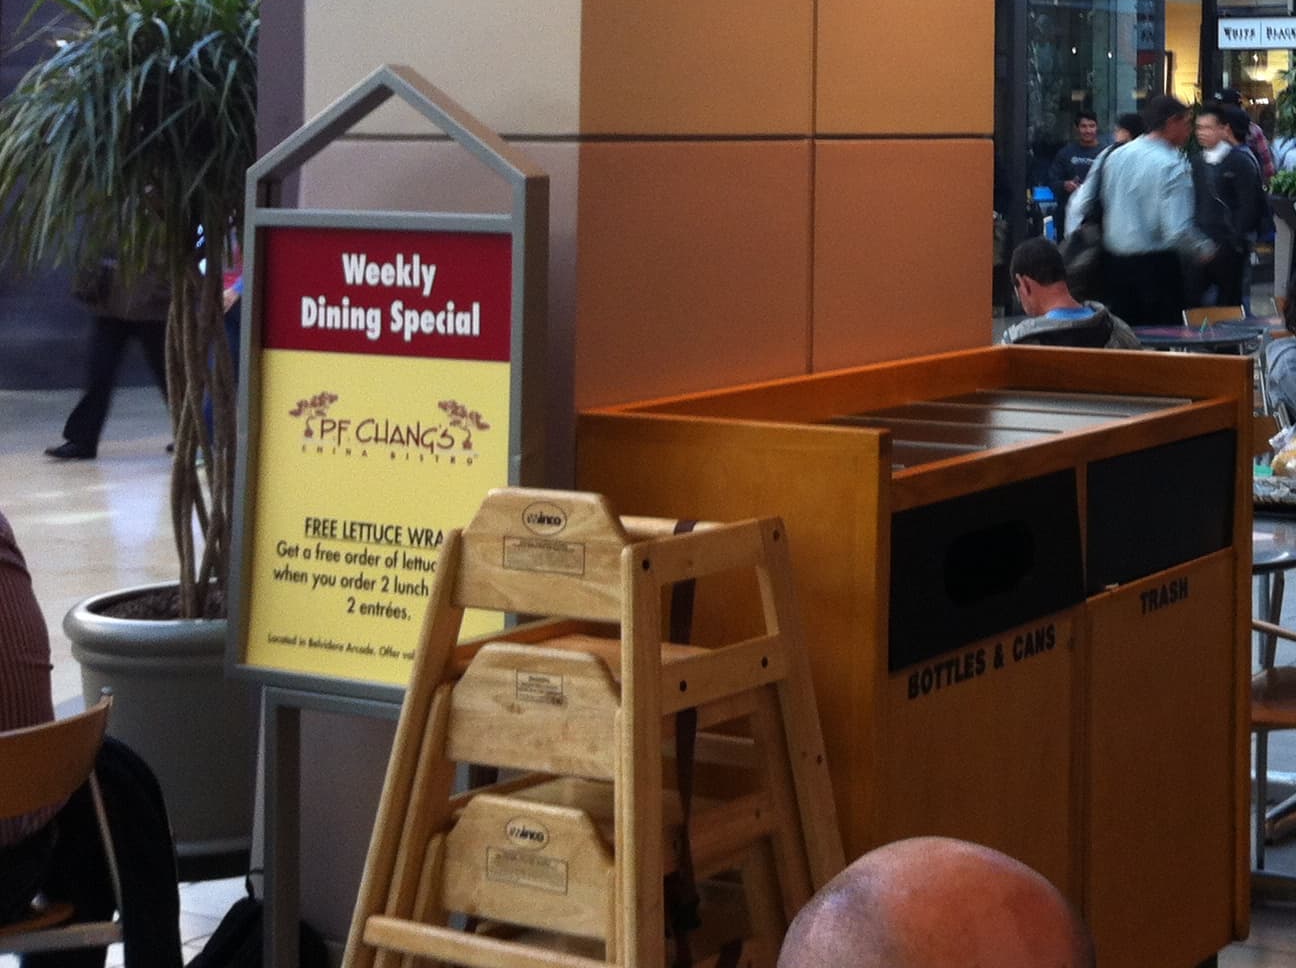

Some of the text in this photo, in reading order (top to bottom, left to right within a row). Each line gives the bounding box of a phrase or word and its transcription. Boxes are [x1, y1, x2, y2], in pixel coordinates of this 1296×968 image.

[342, 253, 437, 297] Weekly
[301, 295, 481, 342] Dining Special
[304, 517, 338, 539] FREE
[342, 521, 403, 545] LETTUCE
[276, 540, 300, 558] Get
[303, 547, 312, 560] a
[316, 542, 341, 564] free
[345, 547, 380, 567] order
[384, 550, 399, 569] of
[273, 565, 429, 597] when you order 2 lunch
[1140, 576, 1190, 616] TRASH
[347, 597, 356, 614] 2
[907, 624, 1057, 700] BOTTLES & CANS
